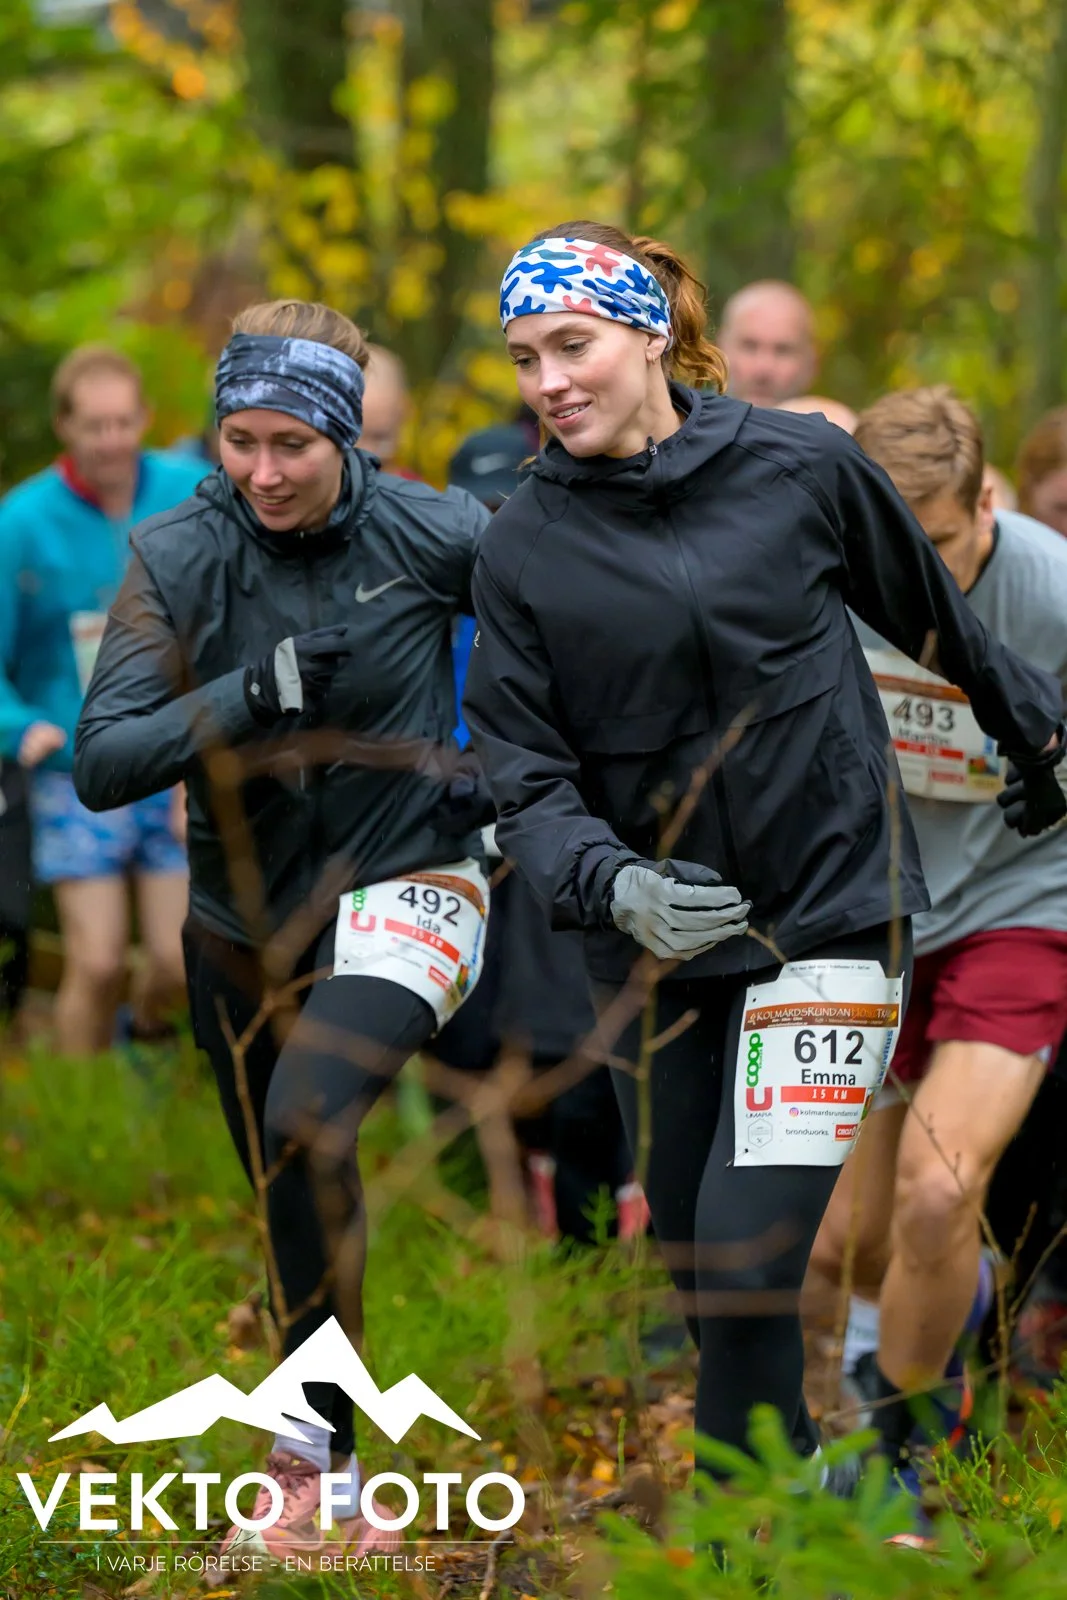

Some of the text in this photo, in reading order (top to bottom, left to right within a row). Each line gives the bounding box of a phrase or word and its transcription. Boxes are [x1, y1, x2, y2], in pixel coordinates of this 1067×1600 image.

[893, 697, 955, 732] 493
[398, 886, 461, 927] 492
[416, 915, 441, 934] Ida
[746, 1032, 763, 1087] coop
[793, 1029, 864, 1065] 612
[801, 1068, 856, 1086] Emma
[811, 1088, 827, 1100] 15
